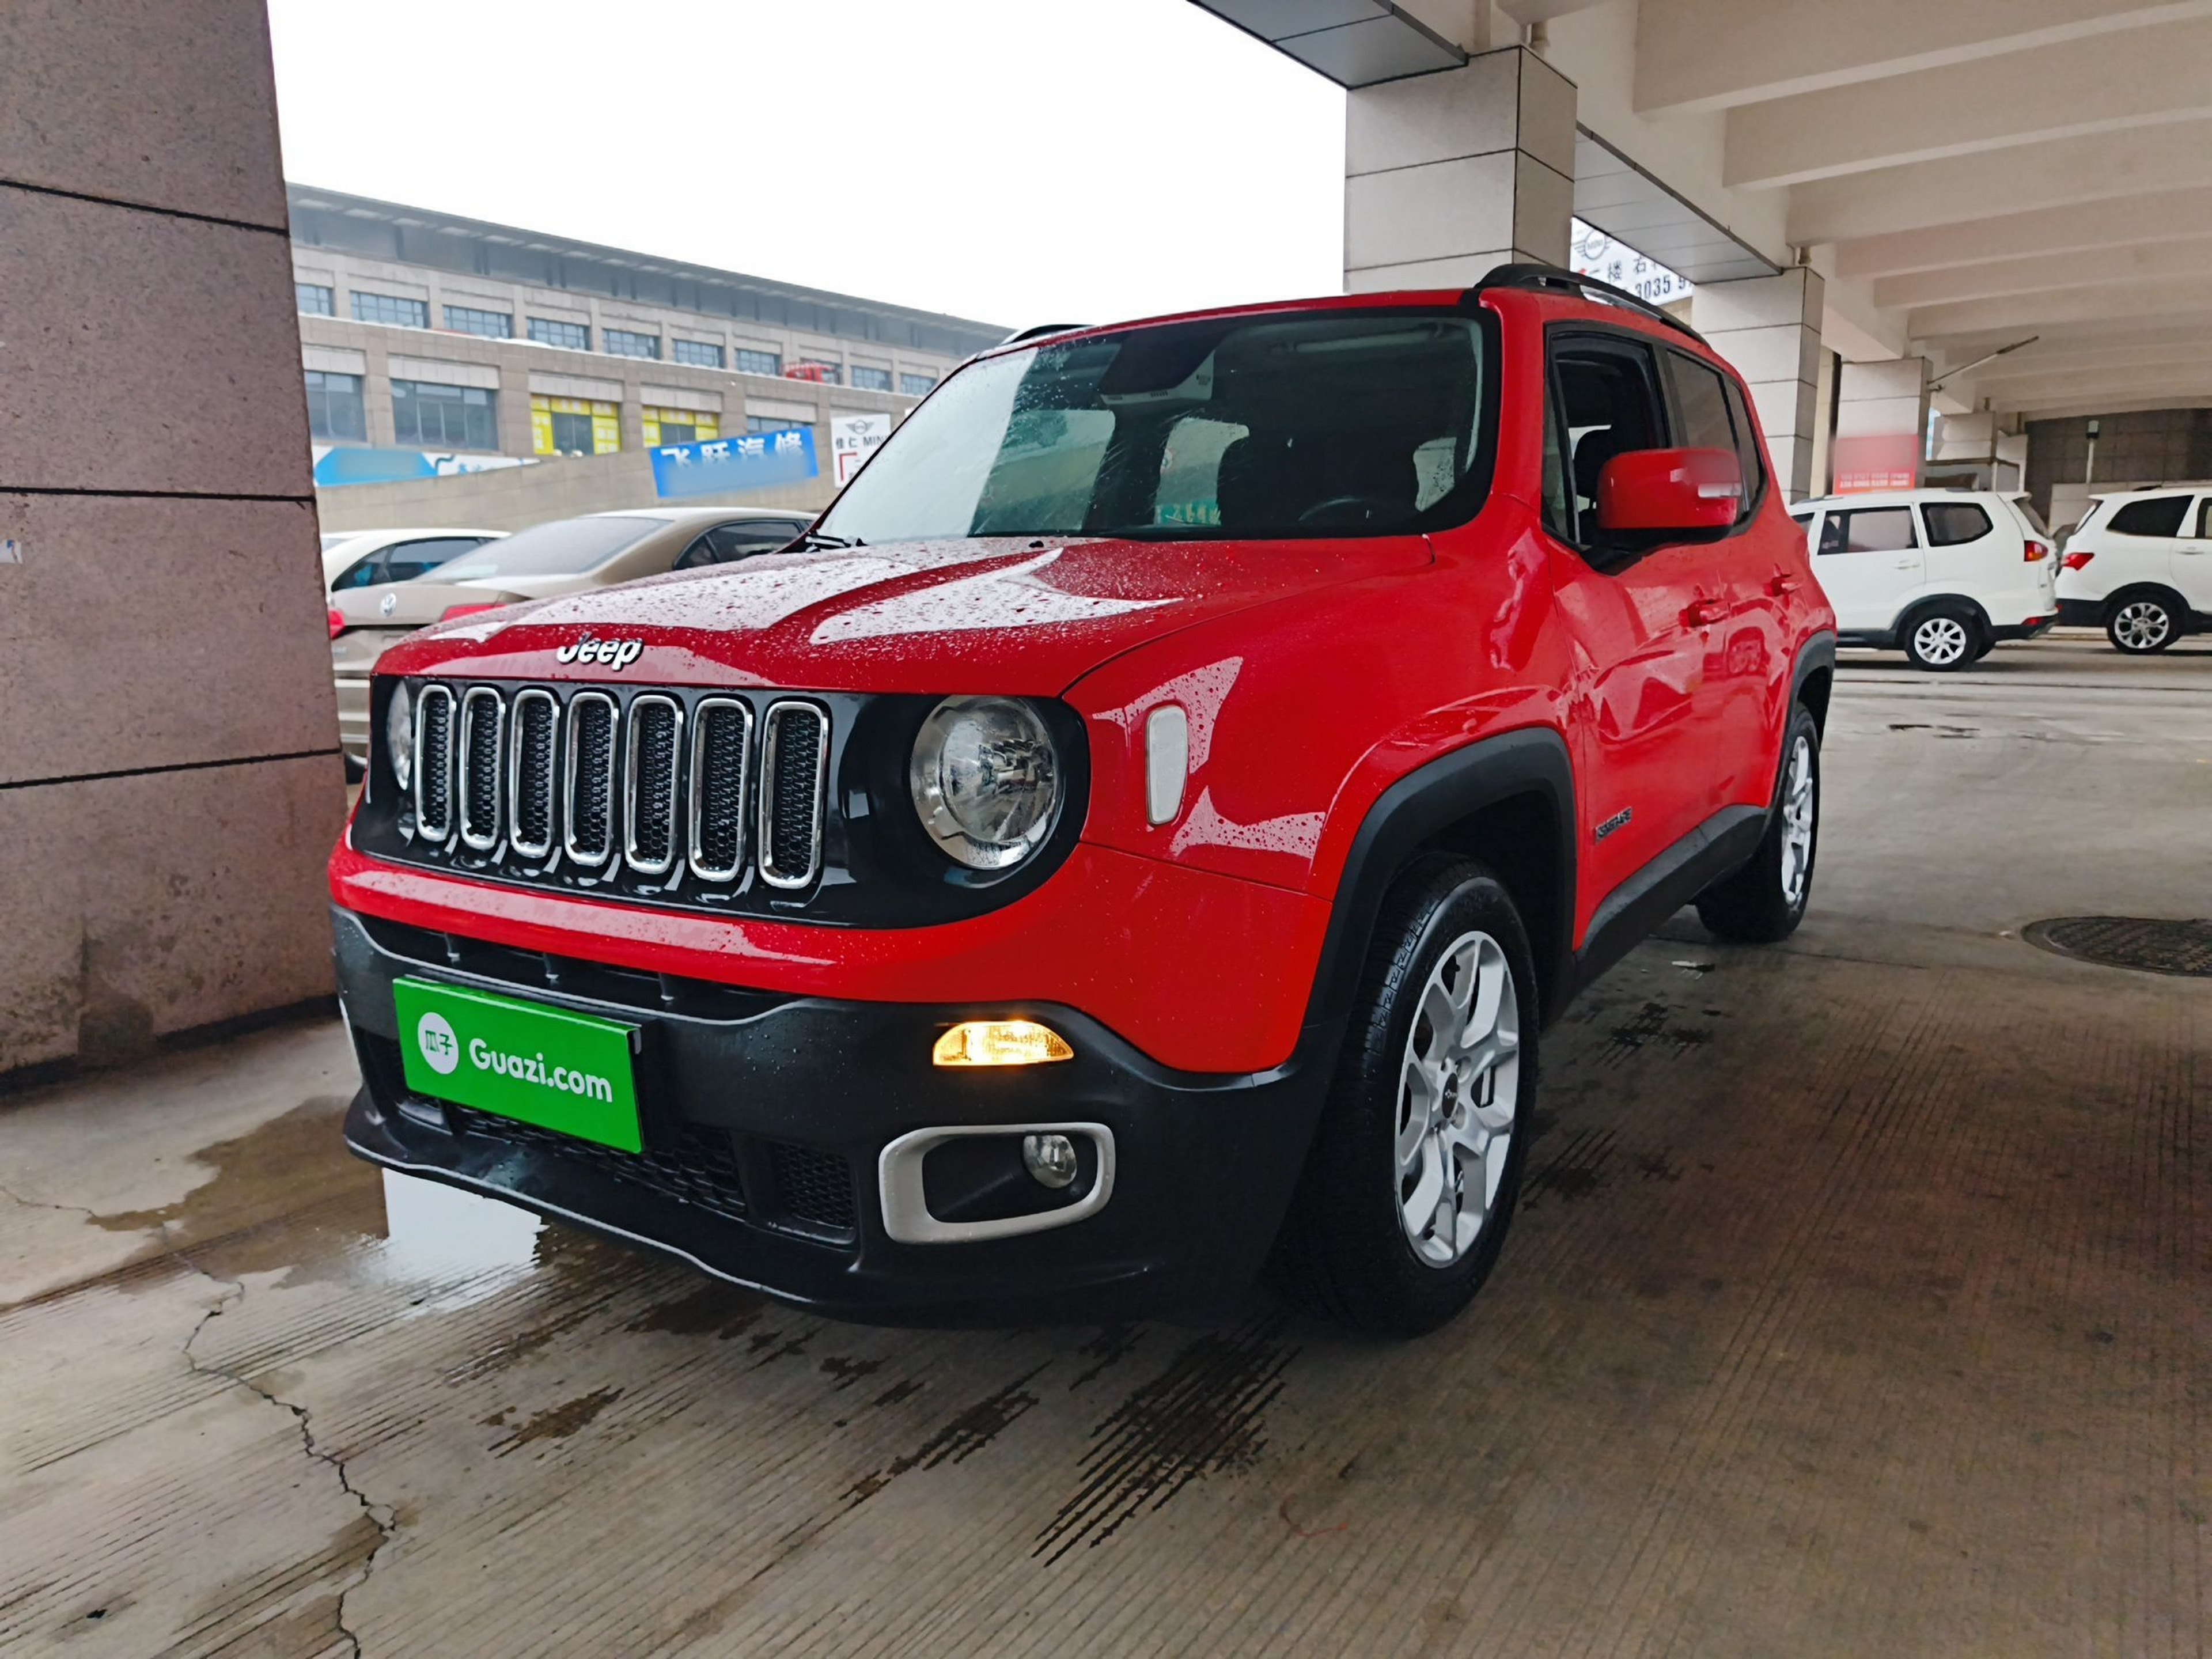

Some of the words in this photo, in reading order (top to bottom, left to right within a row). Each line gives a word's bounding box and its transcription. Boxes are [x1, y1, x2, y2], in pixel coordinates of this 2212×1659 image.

[556, 631, 643, 671] Jeep
[425, 1030, 453, 1055] 瓜子
[469, 1038, 612, 1103] Guazi.com
